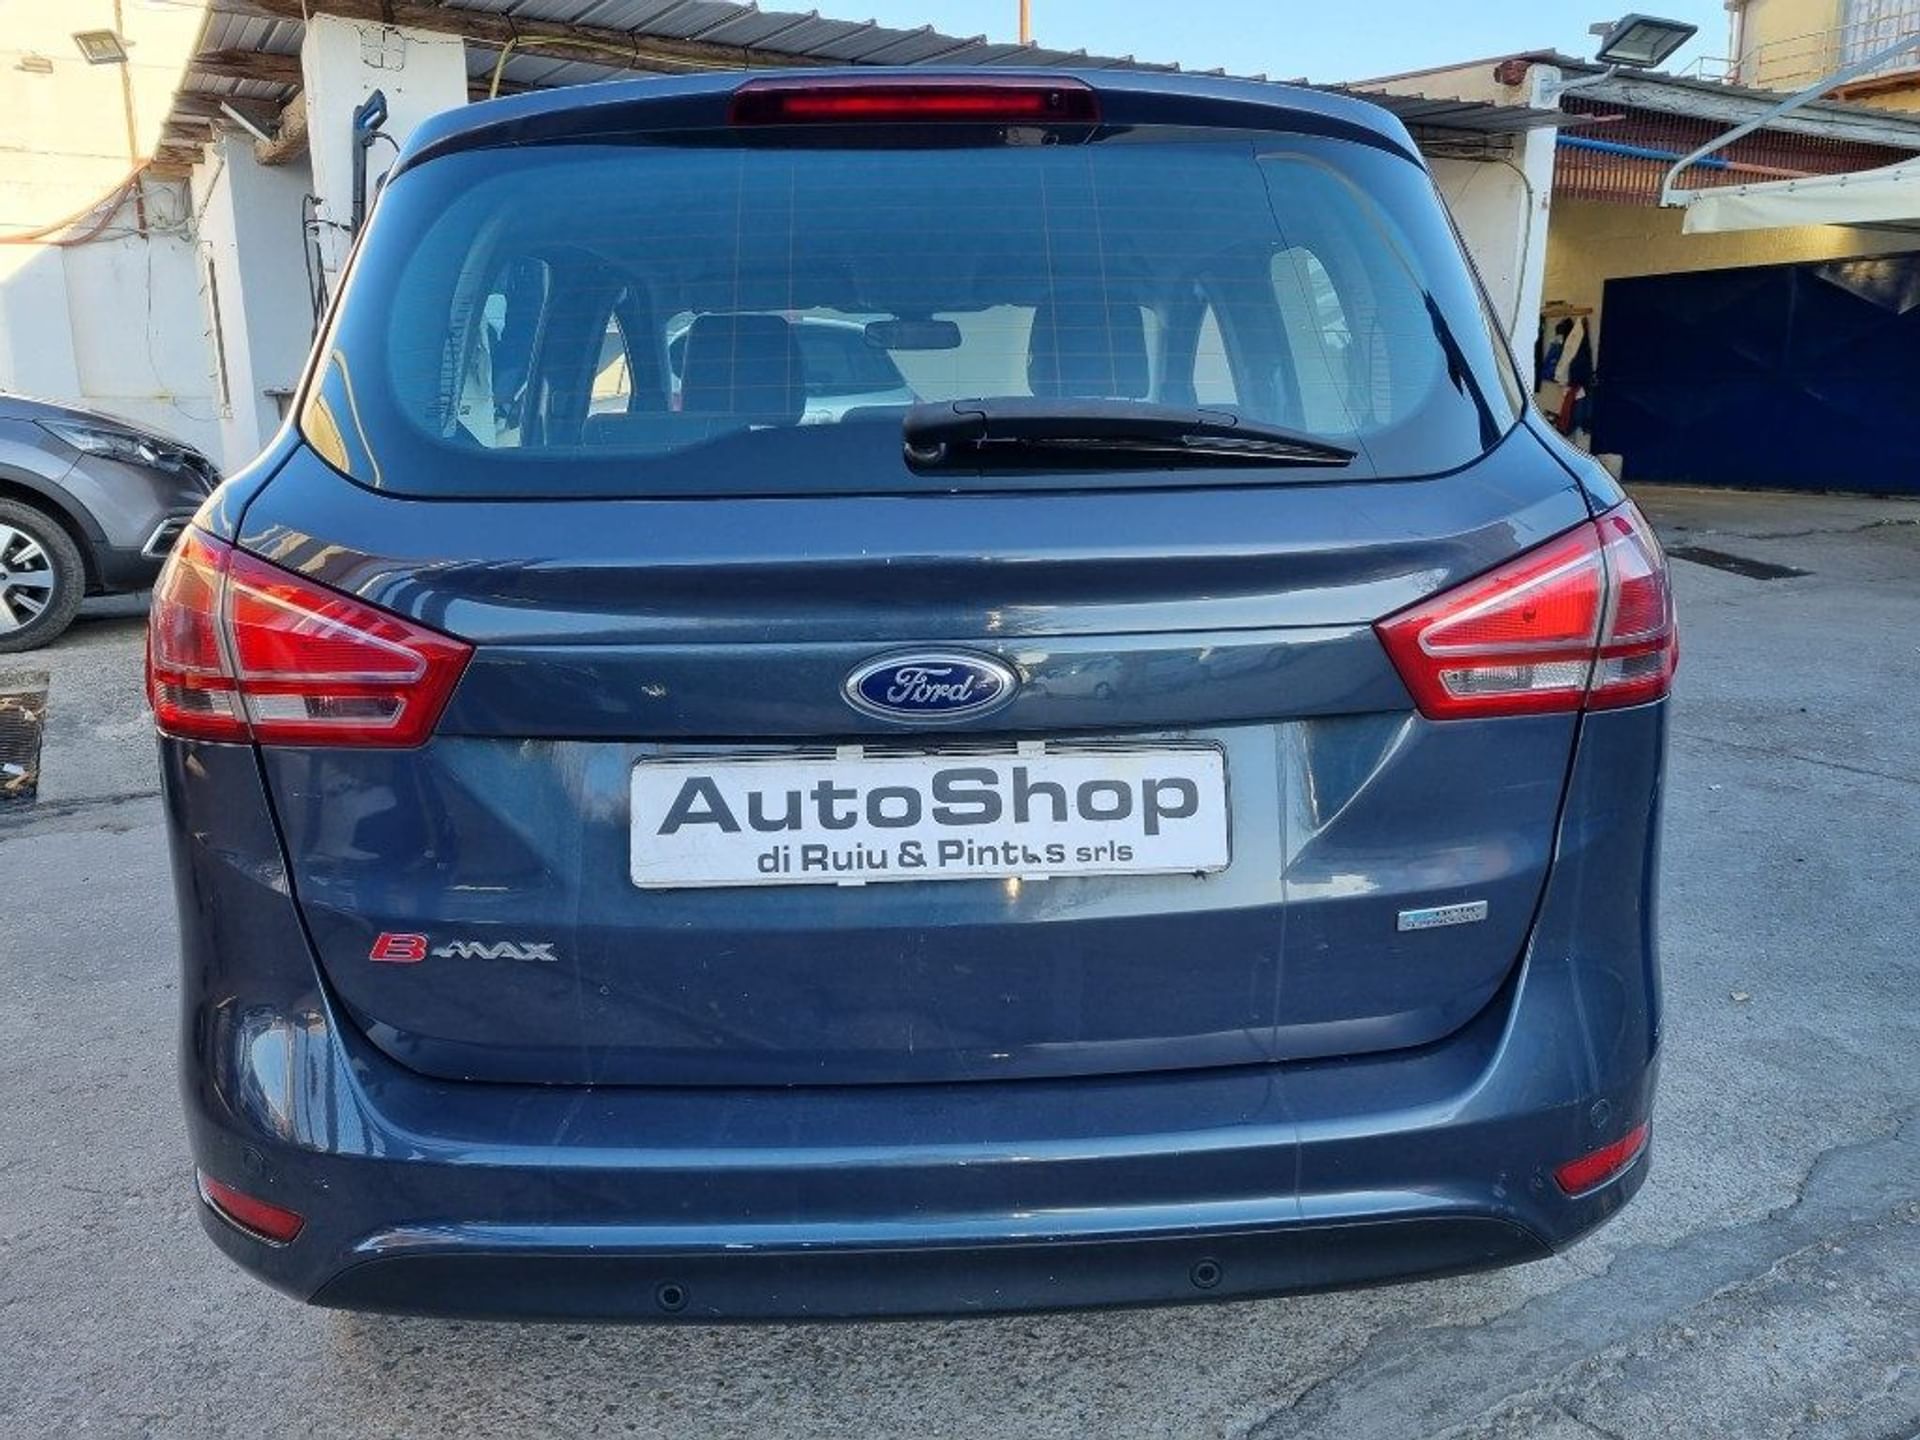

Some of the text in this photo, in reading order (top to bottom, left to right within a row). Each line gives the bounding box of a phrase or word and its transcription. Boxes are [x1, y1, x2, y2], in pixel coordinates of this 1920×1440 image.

[887, 667, 974, 703] Ford
[656, 766, 1199, 836] AutoShop
[757, 845, 790, 873] di
[801, 842, 888, 872] Ruiu
[898, 840, 927, 868] &
[1076, 840, 1134, 862] srls
